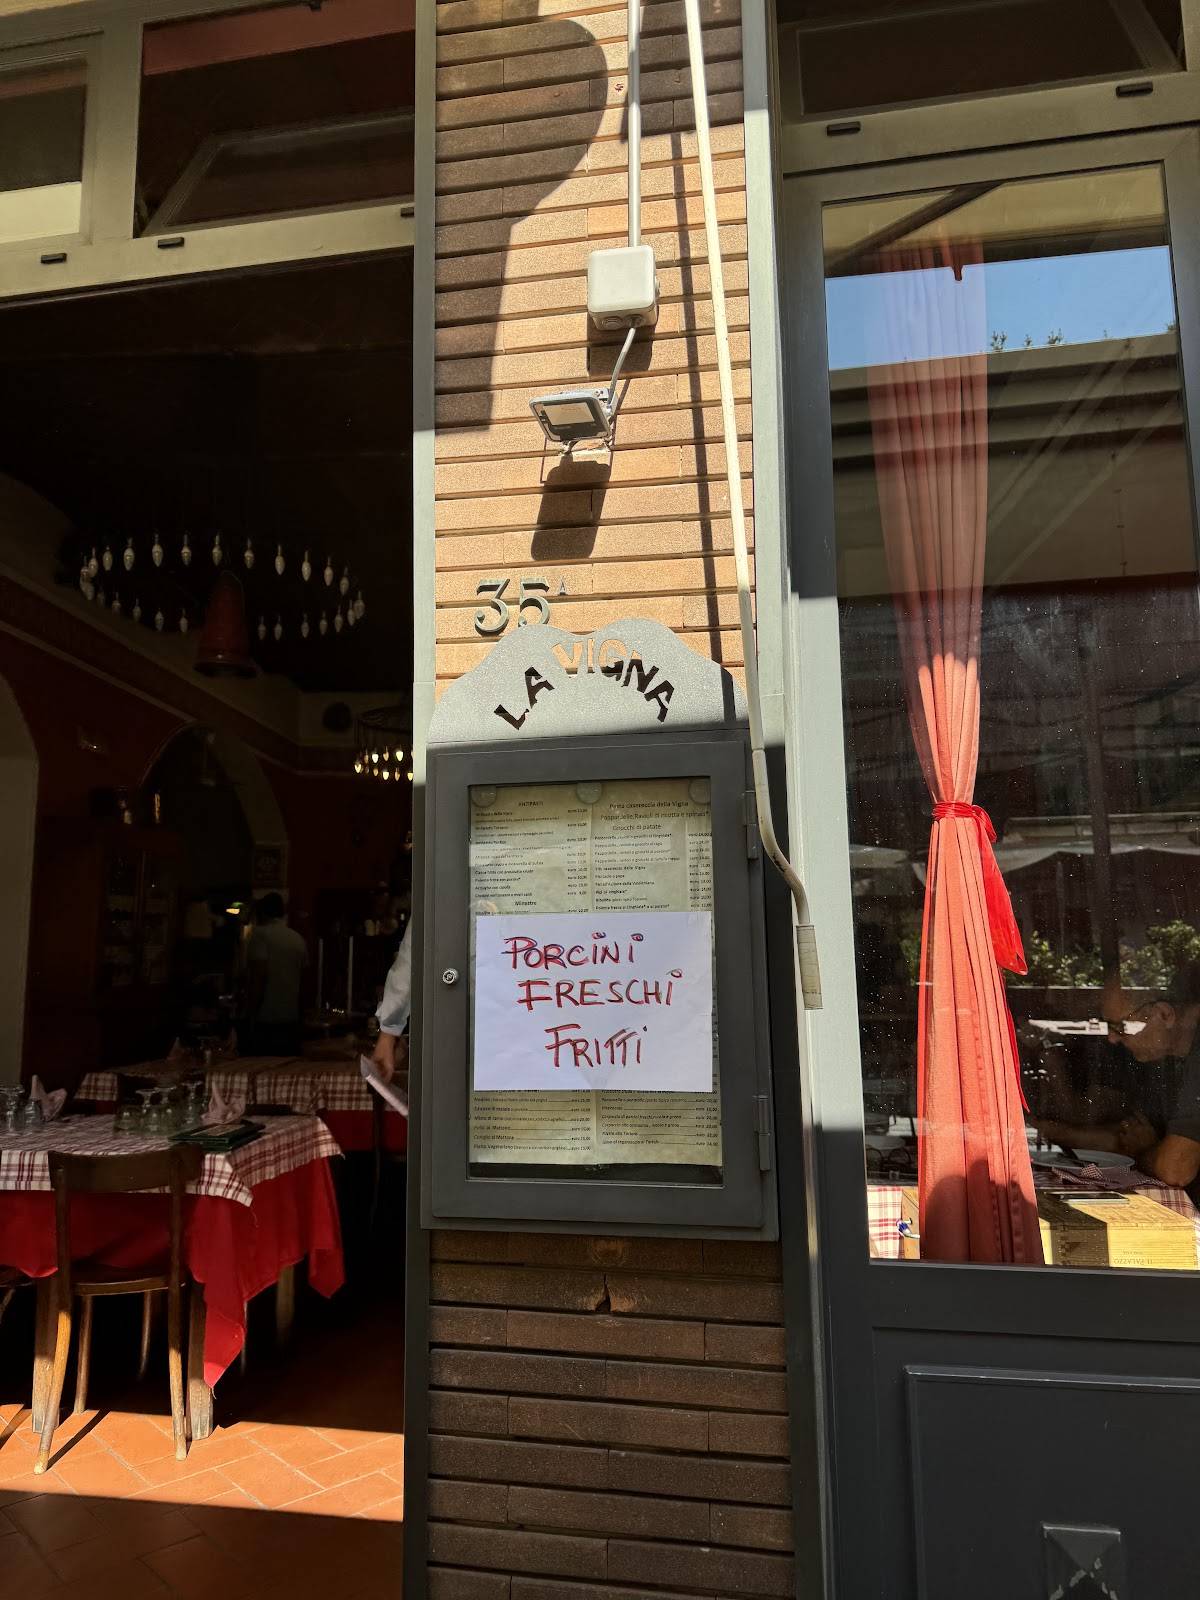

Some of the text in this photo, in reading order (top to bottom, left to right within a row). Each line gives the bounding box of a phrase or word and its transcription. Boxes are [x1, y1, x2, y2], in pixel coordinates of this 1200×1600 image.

[493, 638, 675, 730] LA VIGNA
[501, 931, 645, 970] PORCINI
[517, 968, 684, 1012] FRESCHI
[544, 1023, 648, 1068] FRITTI
